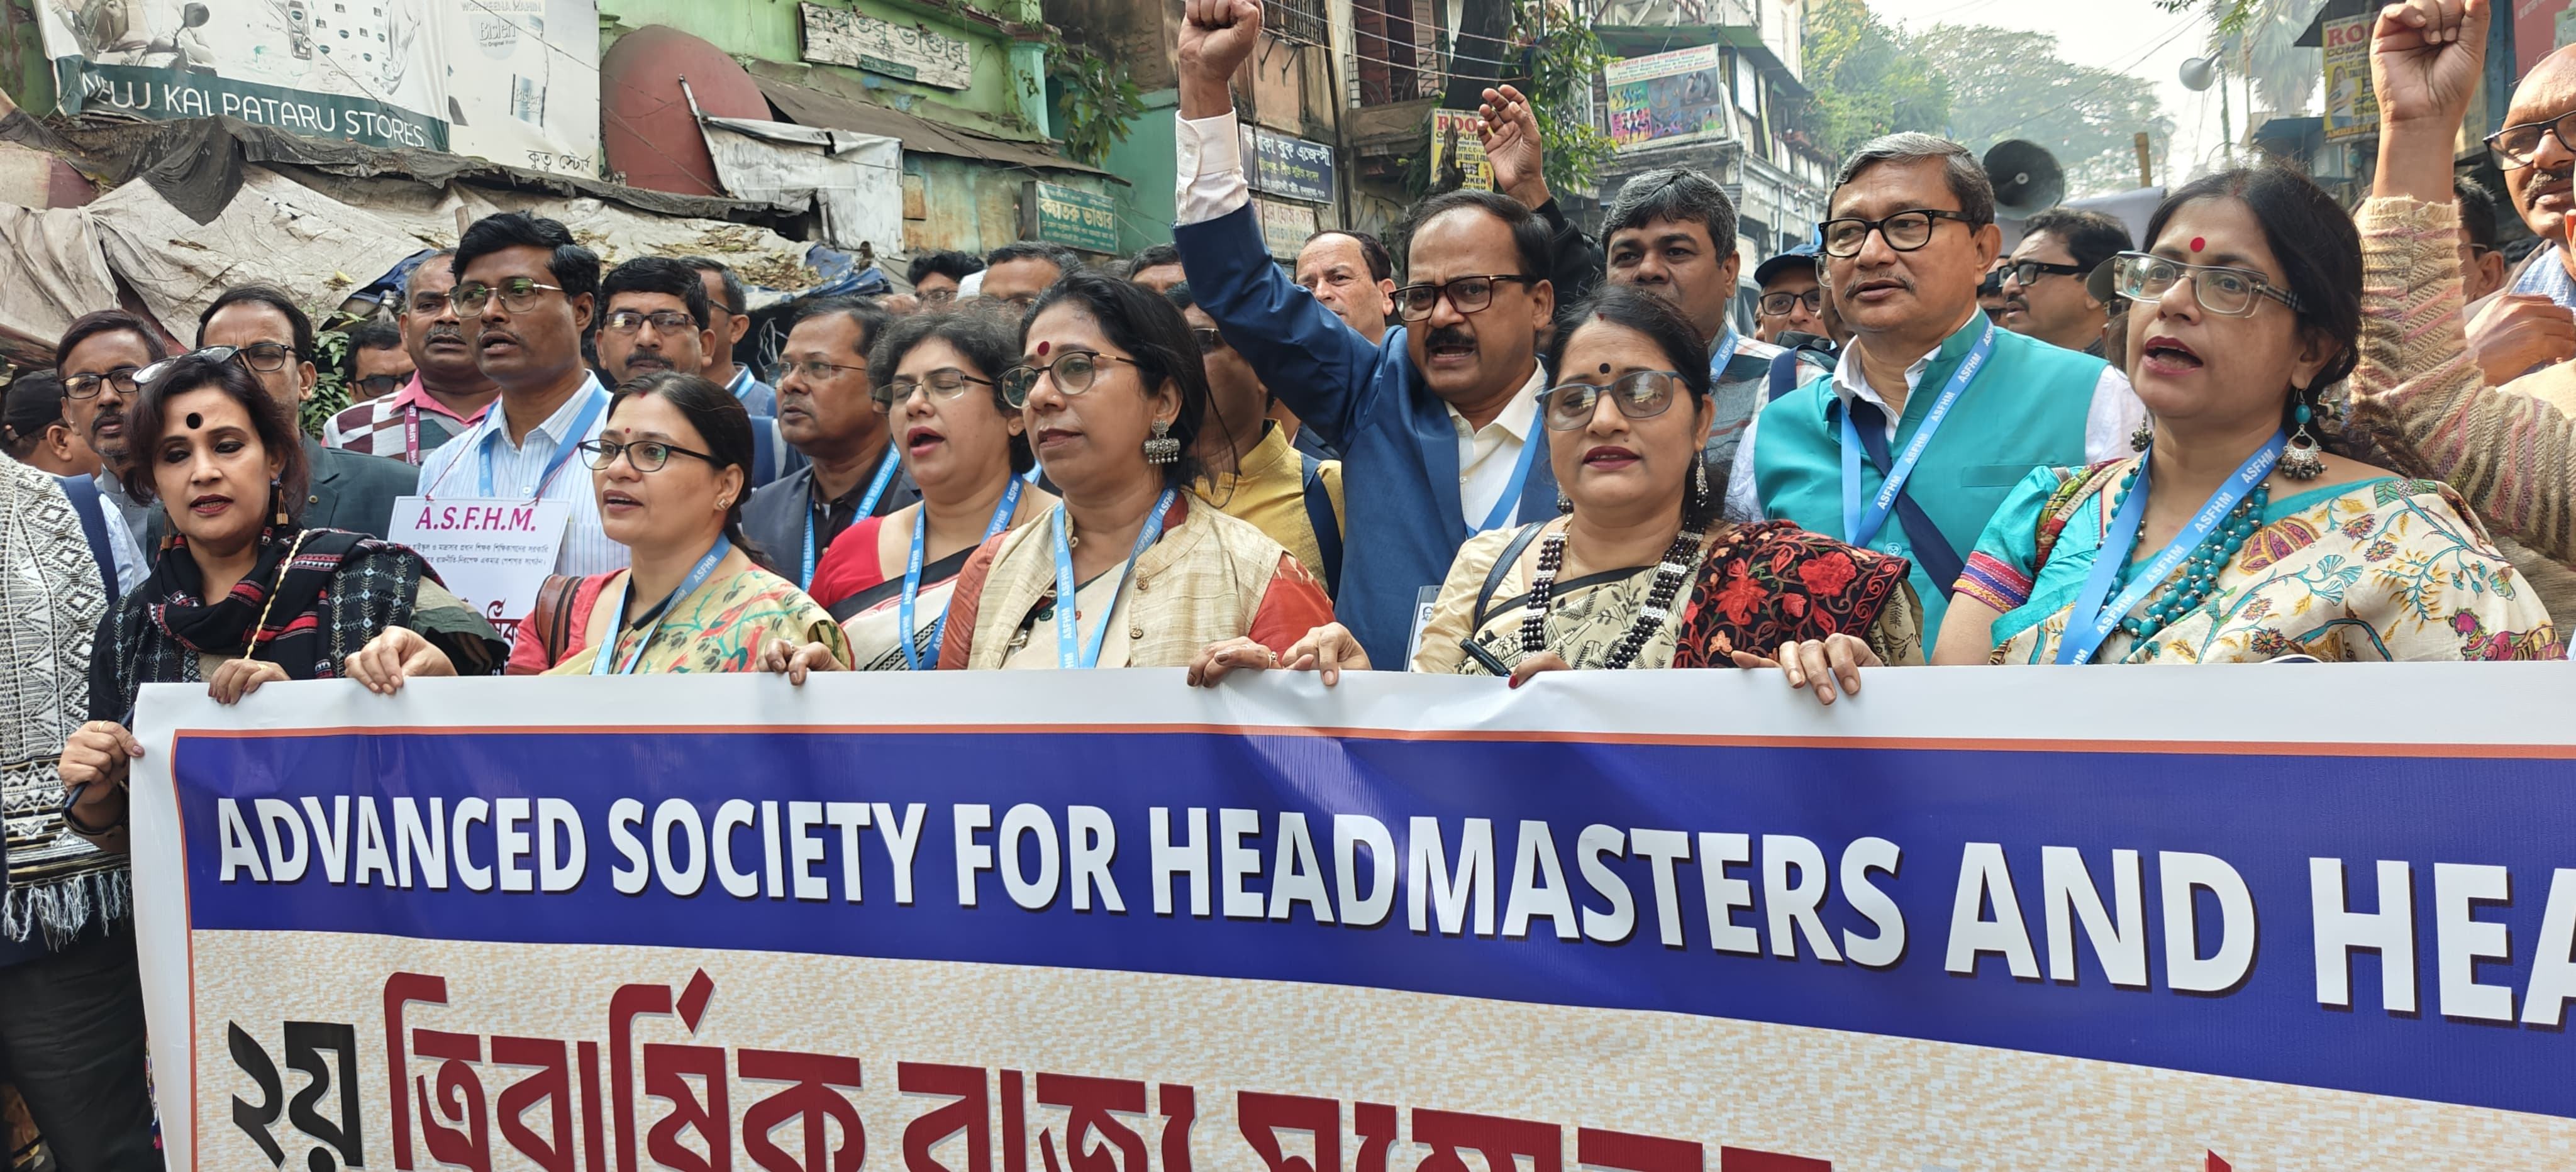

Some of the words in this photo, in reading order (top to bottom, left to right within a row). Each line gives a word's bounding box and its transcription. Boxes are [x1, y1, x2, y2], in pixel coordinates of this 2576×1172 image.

[82, 74, 151, 109] NEW
[345, 110, 426, 148] STORES
[1438, 116, 1478, 133] ROO
[1719, 337, 1734, 361] ASFHM
[1957, 353, 1982, 384] ASFHM
[1931, 391, 1956, 423] ASFHM
[1904, 433, 1929, 465] ASFHM
[2240, 448, 2276, 484] ASFHM
[1007, 480, 1019, 503] ASFHM
[1159, 489, 1175, 516] ASFHM
[1877, 475, 1902, 510] ASFHM
[415, 506, 537, 532] A.S.F.H.M.
[2194, 492, 2234, 533] ASFHM
[693, 554, 718, 583] ASFHM
[910, 549, 920, 573] ASFHM
[2146, 544, 2185, 584] ASFHM
[904, 582, 916, 605] ASFHM
[1060, 565, 1070, 597] ASFHM
[1062, 607, 1072, 639] ASFHM
[2096, 594, 2136, 636] ASFHM
[217, 794, 587, 893] ADVANCED
[609, 797, 927, 905] SOCIETY
[953, 803, 1126, 913] FOR
[1148, 807, 1907, 968] HEADMASTERS
[1944, 841, 2260, 993] AND
